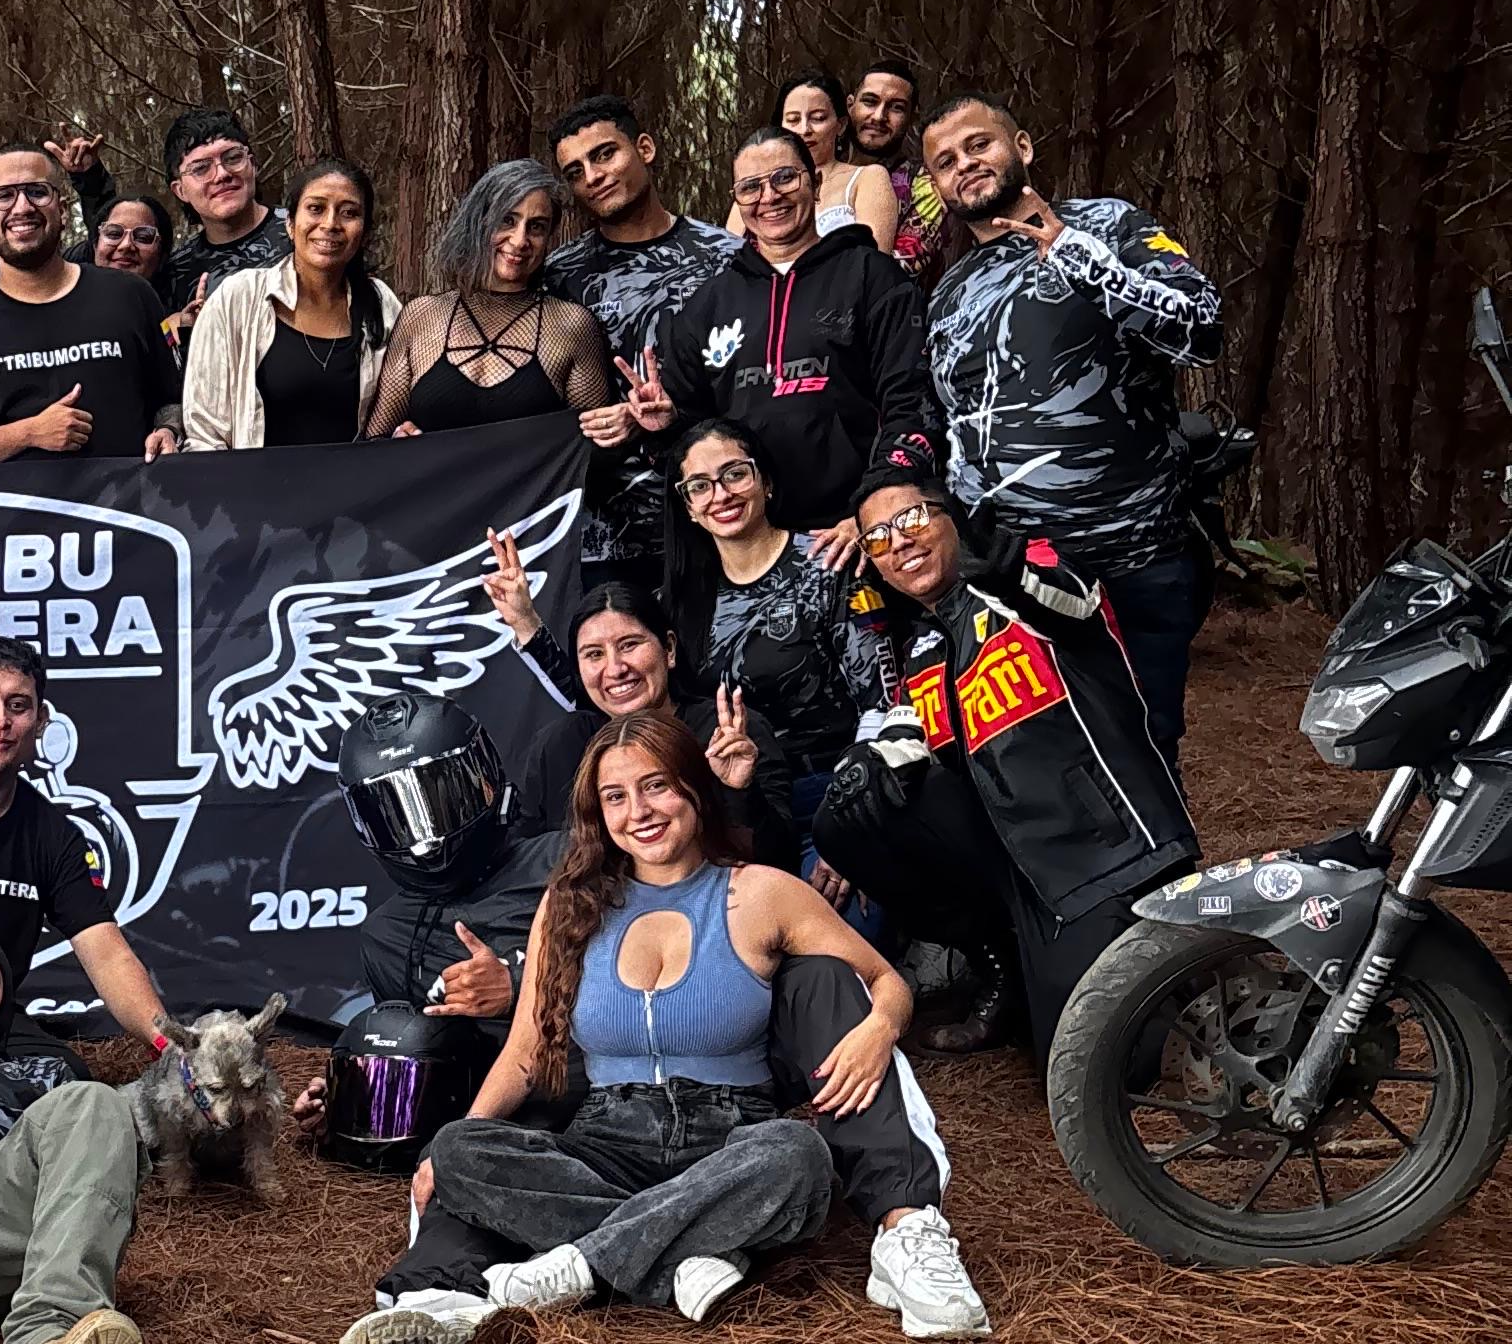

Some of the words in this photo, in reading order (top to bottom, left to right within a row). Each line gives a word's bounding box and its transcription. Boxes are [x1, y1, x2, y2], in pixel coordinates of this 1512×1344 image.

[3, 341, 123, 371] TRIBUMOTERA
[249, 885, 368, 932] 2025
[1334, 955, 1397, 1035] YAMAHA
